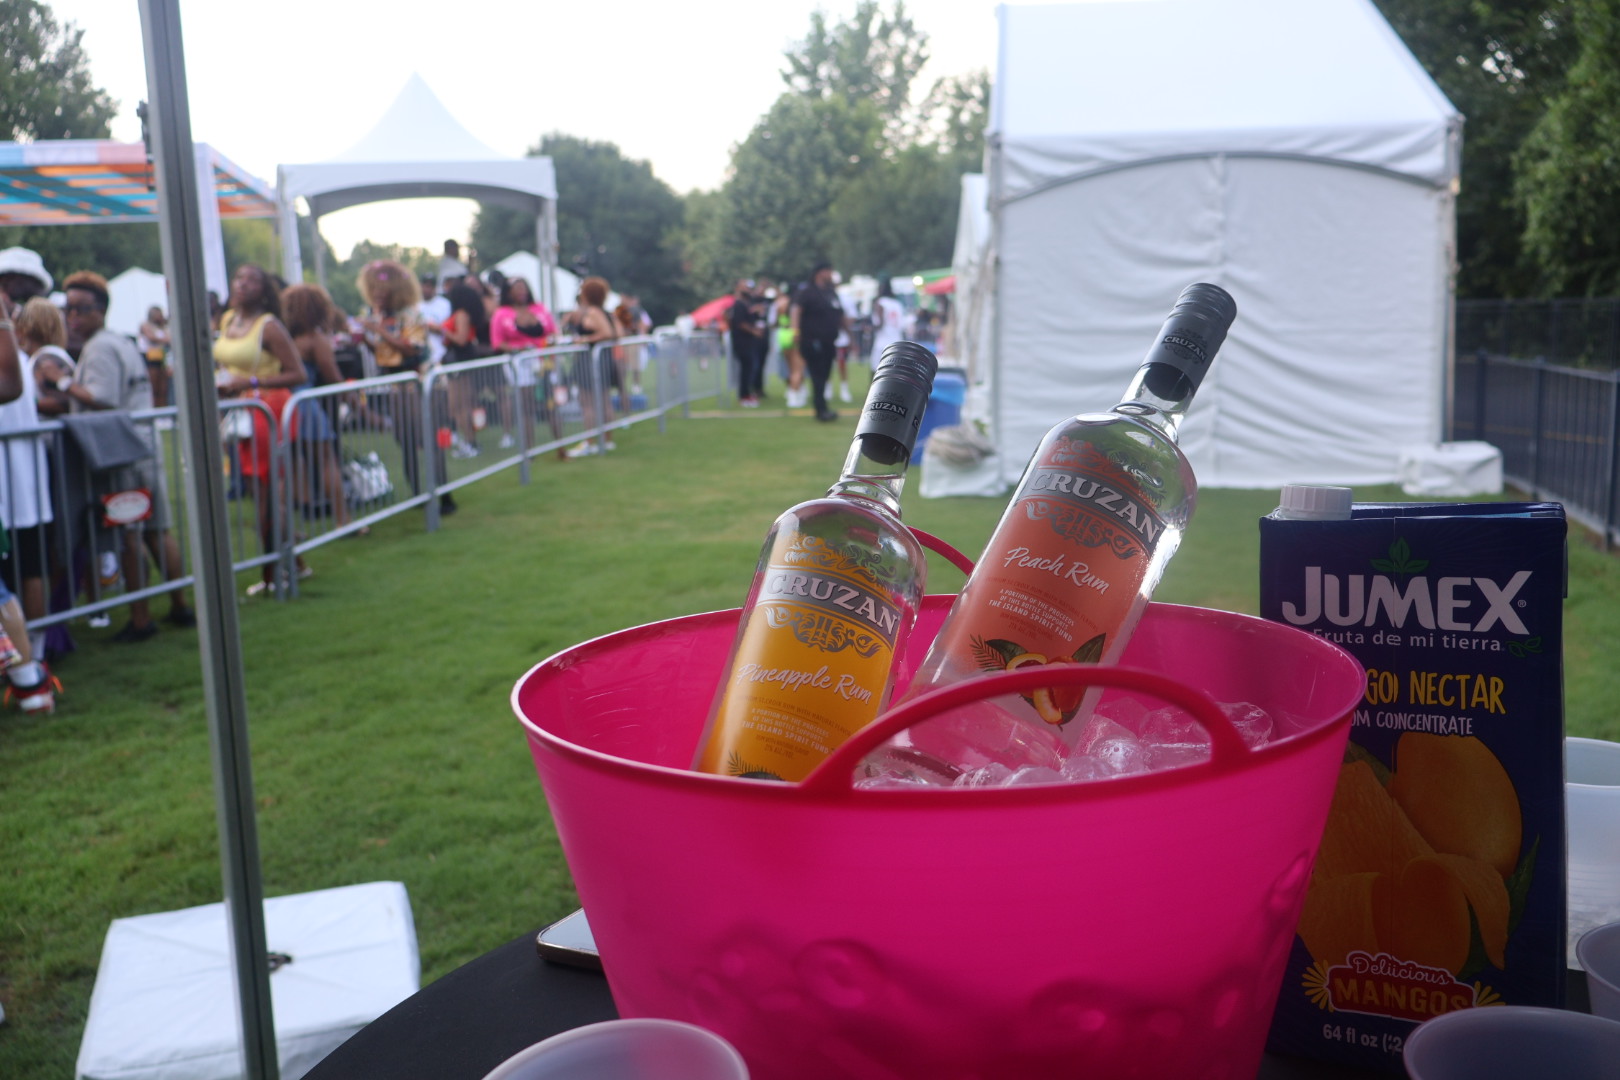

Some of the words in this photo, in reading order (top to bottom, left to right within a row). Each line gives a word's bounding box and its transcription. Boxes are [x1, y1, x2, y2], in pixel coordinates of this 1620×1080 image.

[1164, 336, 1206, 360] CRUZAN
[870, 402, 907, 416] RUZAN
[1031, 472, 1160, 544] CRUZAN
[1004, 546, 1064, 577] Peach
[1064, 562, 1110, 595] Rum
[768, 574, 898, 634] CRUZAN
[1005, 589, 1029, 601] PORTION
[1038, 601, 1048, 610] THE
[1282, 566, 1534, 635] JUMEX
[988, 599, 1002, 608] THE
[1002, 603, 1029, 616] ISLAND
[1030, 614, 1054, 630] SPIRIT
[1054, 626, 1073, 642] FUND
[1314, 629, 1364, 644] Fruta
[1372, 630, 1401, 646] de
[1410, 633, 1434, 647] mi
[1442, 634, 1500, 651] tierra
[737, 663, 832, 692] Pineapple
[834, 674, 872, 704] Rum
[1409, 670, 1506, 714] NECTAR
[756, 723, 783, 735] ISLAND
[785, 731, 810, 745] SPIRIT
[1376, 711, 1472, 735] CONCENTRATE
[1334, 978, 1468, 1015] MANGOS
[1323, 1024, 1341, 1040] 64
[1346, 1028, 1356, 1044] fl
[1361, 1033, 1378, 1047] oz
